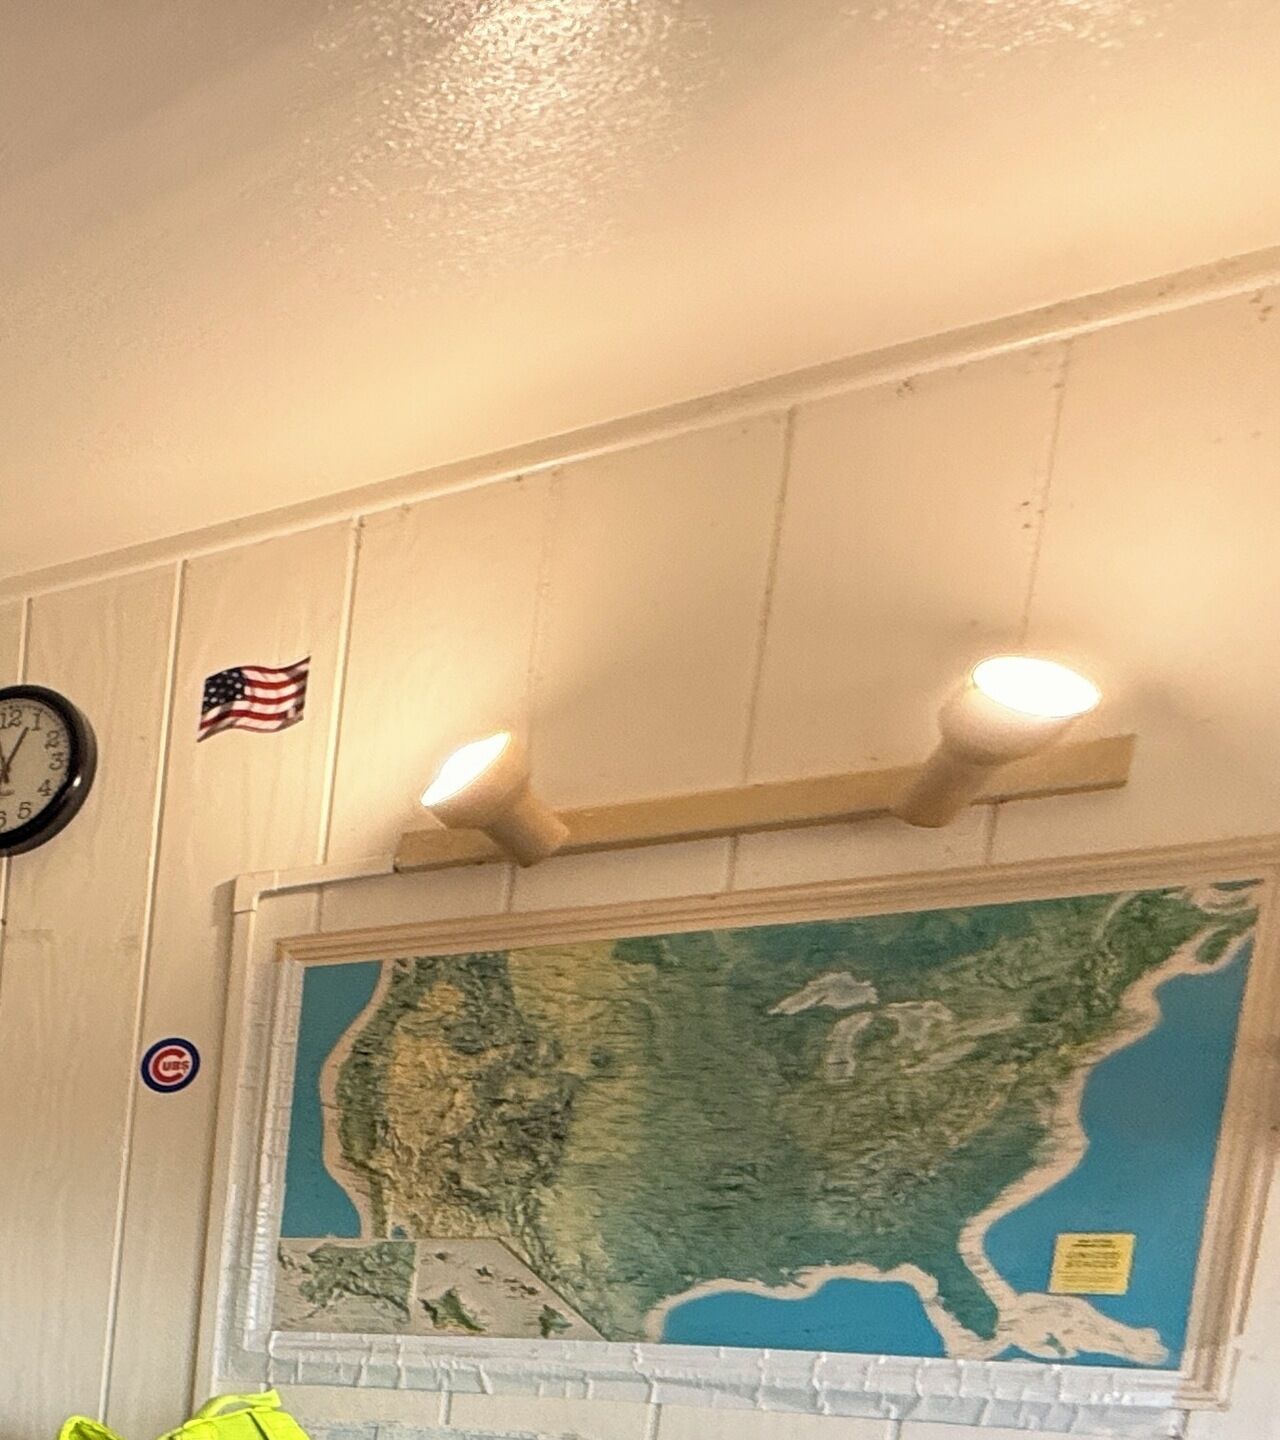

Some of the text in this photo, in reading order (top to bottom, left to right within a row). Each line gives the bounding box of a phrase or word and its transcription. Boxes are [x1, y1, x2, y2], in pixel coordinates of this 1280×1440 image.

[0, 709, 22, 730] 12
[31, 713, 42, 731] 1
[44, 730, 59, 750] 2
[49, 752, 64, 770] 3
[37, 779, 52, 797] 4
[16, 802, 32, 819] 5
